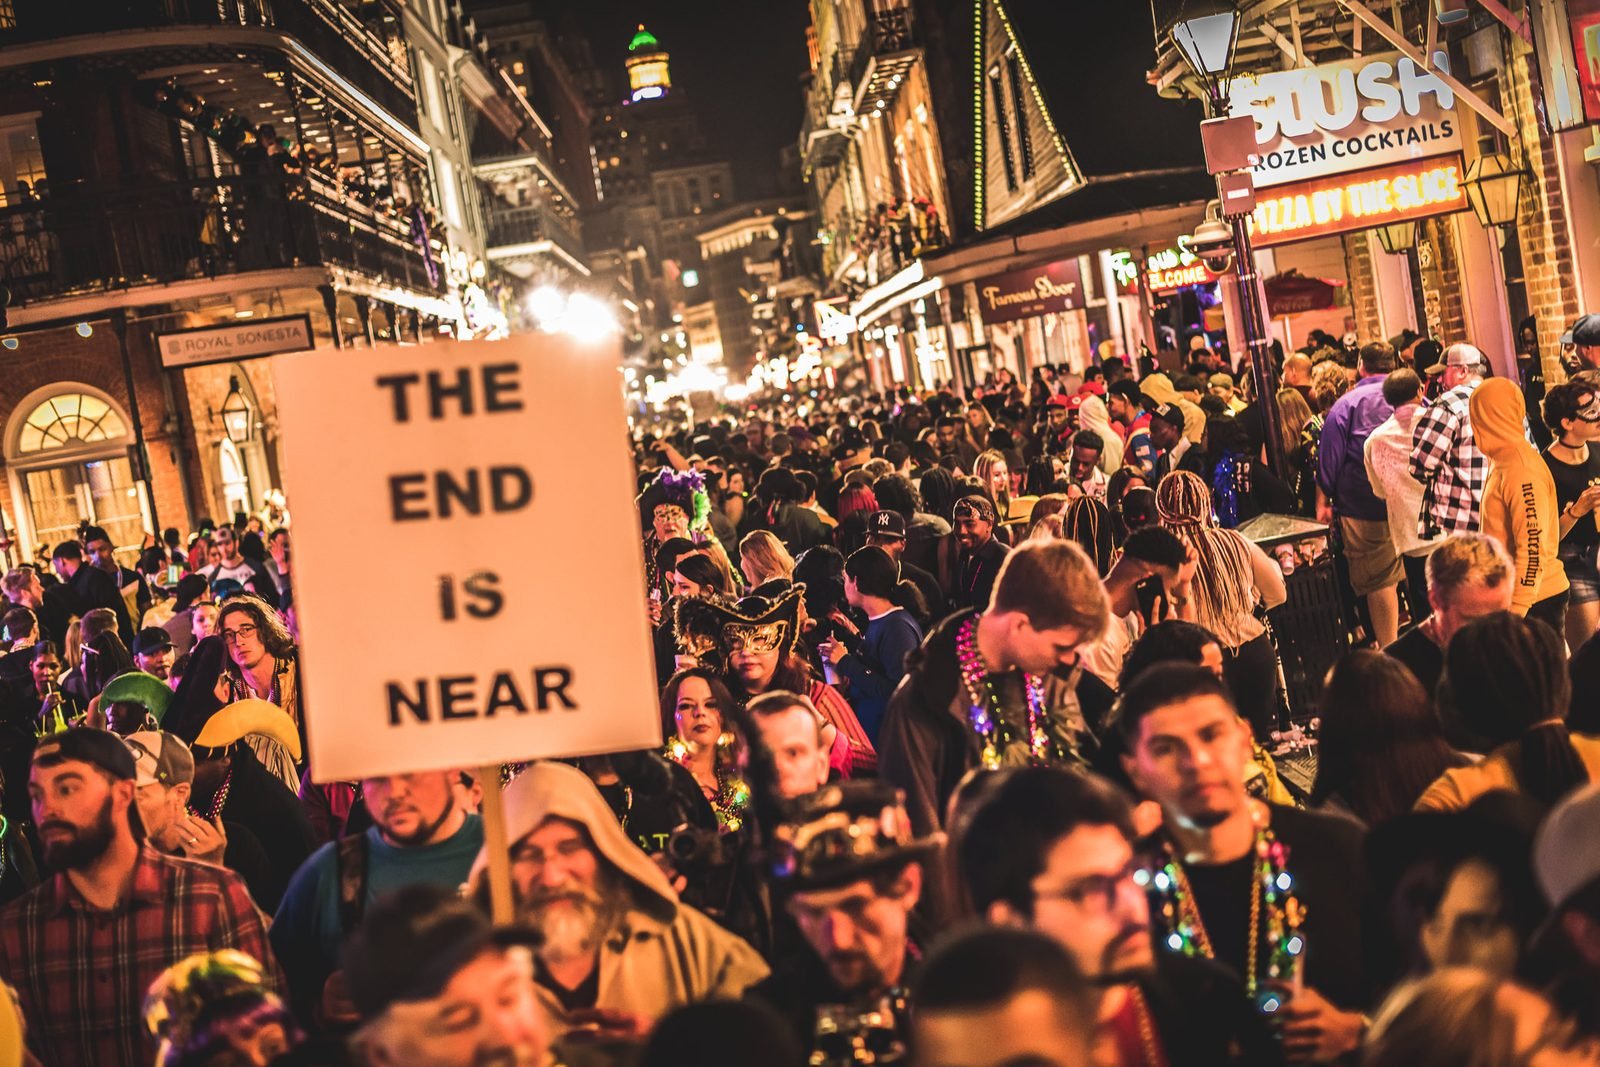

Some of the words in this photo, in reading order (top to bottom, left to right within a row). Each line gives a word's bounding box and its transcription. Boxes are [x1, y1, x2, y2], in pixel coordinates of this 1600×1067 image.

[1252, 143, 1327, 172] ROZEN
[1332, 119, 1454, 158] COCKTAILS
[1312, 188, 1344, 225] BY
[1347, 179, 1392, 218] THE
[1392, 166, 1461, 211] SLICE
[983, 286, 1037, 310] Famous
[1034, 274, 1076, 299] Door
[1148, 266, 1206, 290] ELCOME
[185, 335, 232, 351] ROYAL
[236, 326, 302, 345] SONESTA
[376, 362, 525, 424] THE
[388, 465, 534, 523] END
[1521, 482, 1538, 520] never
[1520, 529, 1543, 588] dreaming
[437, 569, 505, 622] IS
[385, 664, 579, 727] NEAR
